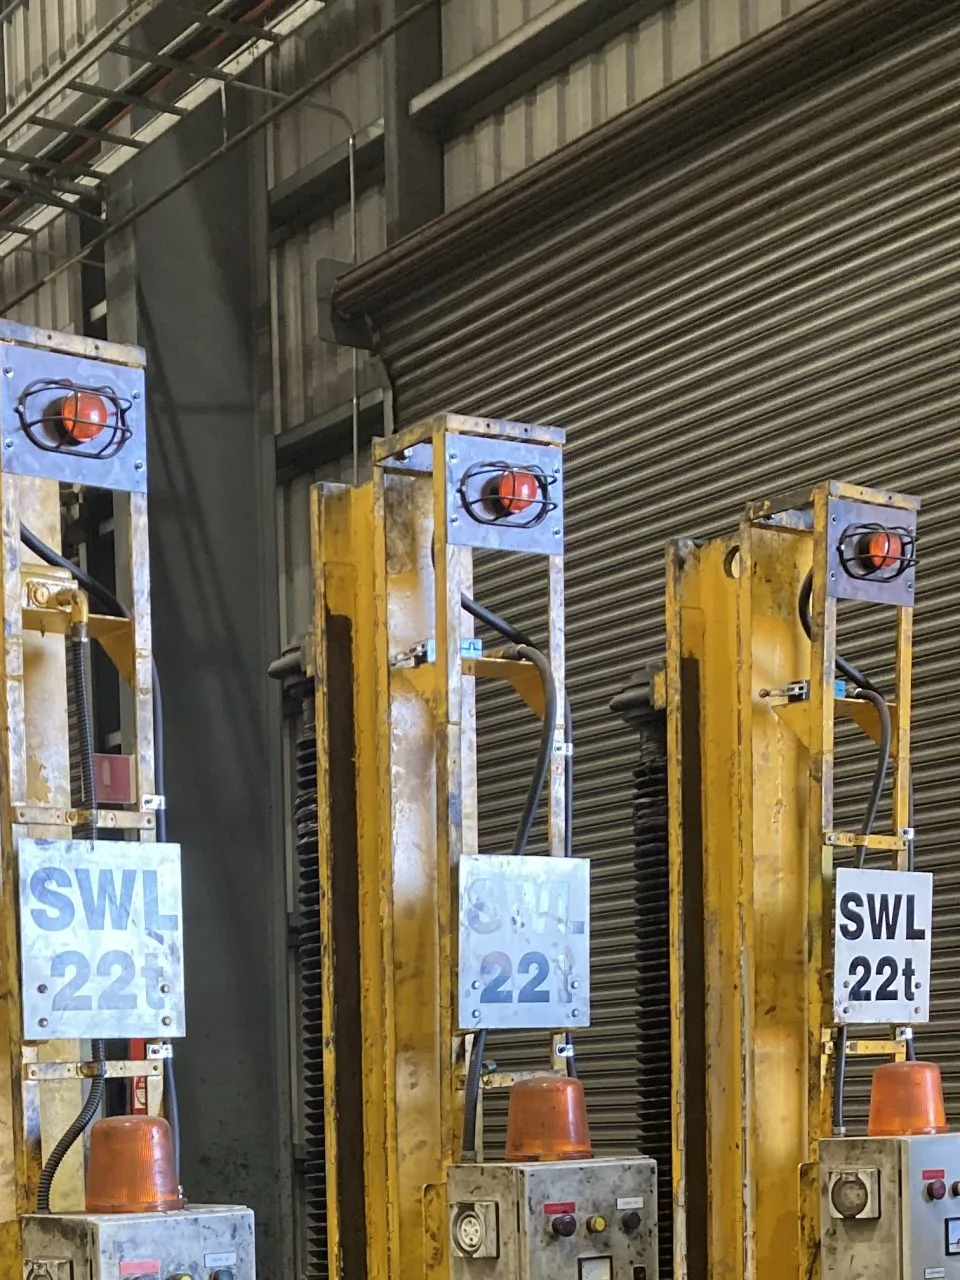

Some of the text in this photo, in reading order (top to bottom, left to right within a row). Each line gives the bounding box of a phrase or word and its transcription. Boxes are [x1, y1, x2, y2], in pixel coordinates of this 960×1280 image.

[29, 866, 179, 932] SWL
[839, 891, 926, 940] SWL
[50, 949, 166, 1011] 22t
[848, 955, 916, 1002] 22t
